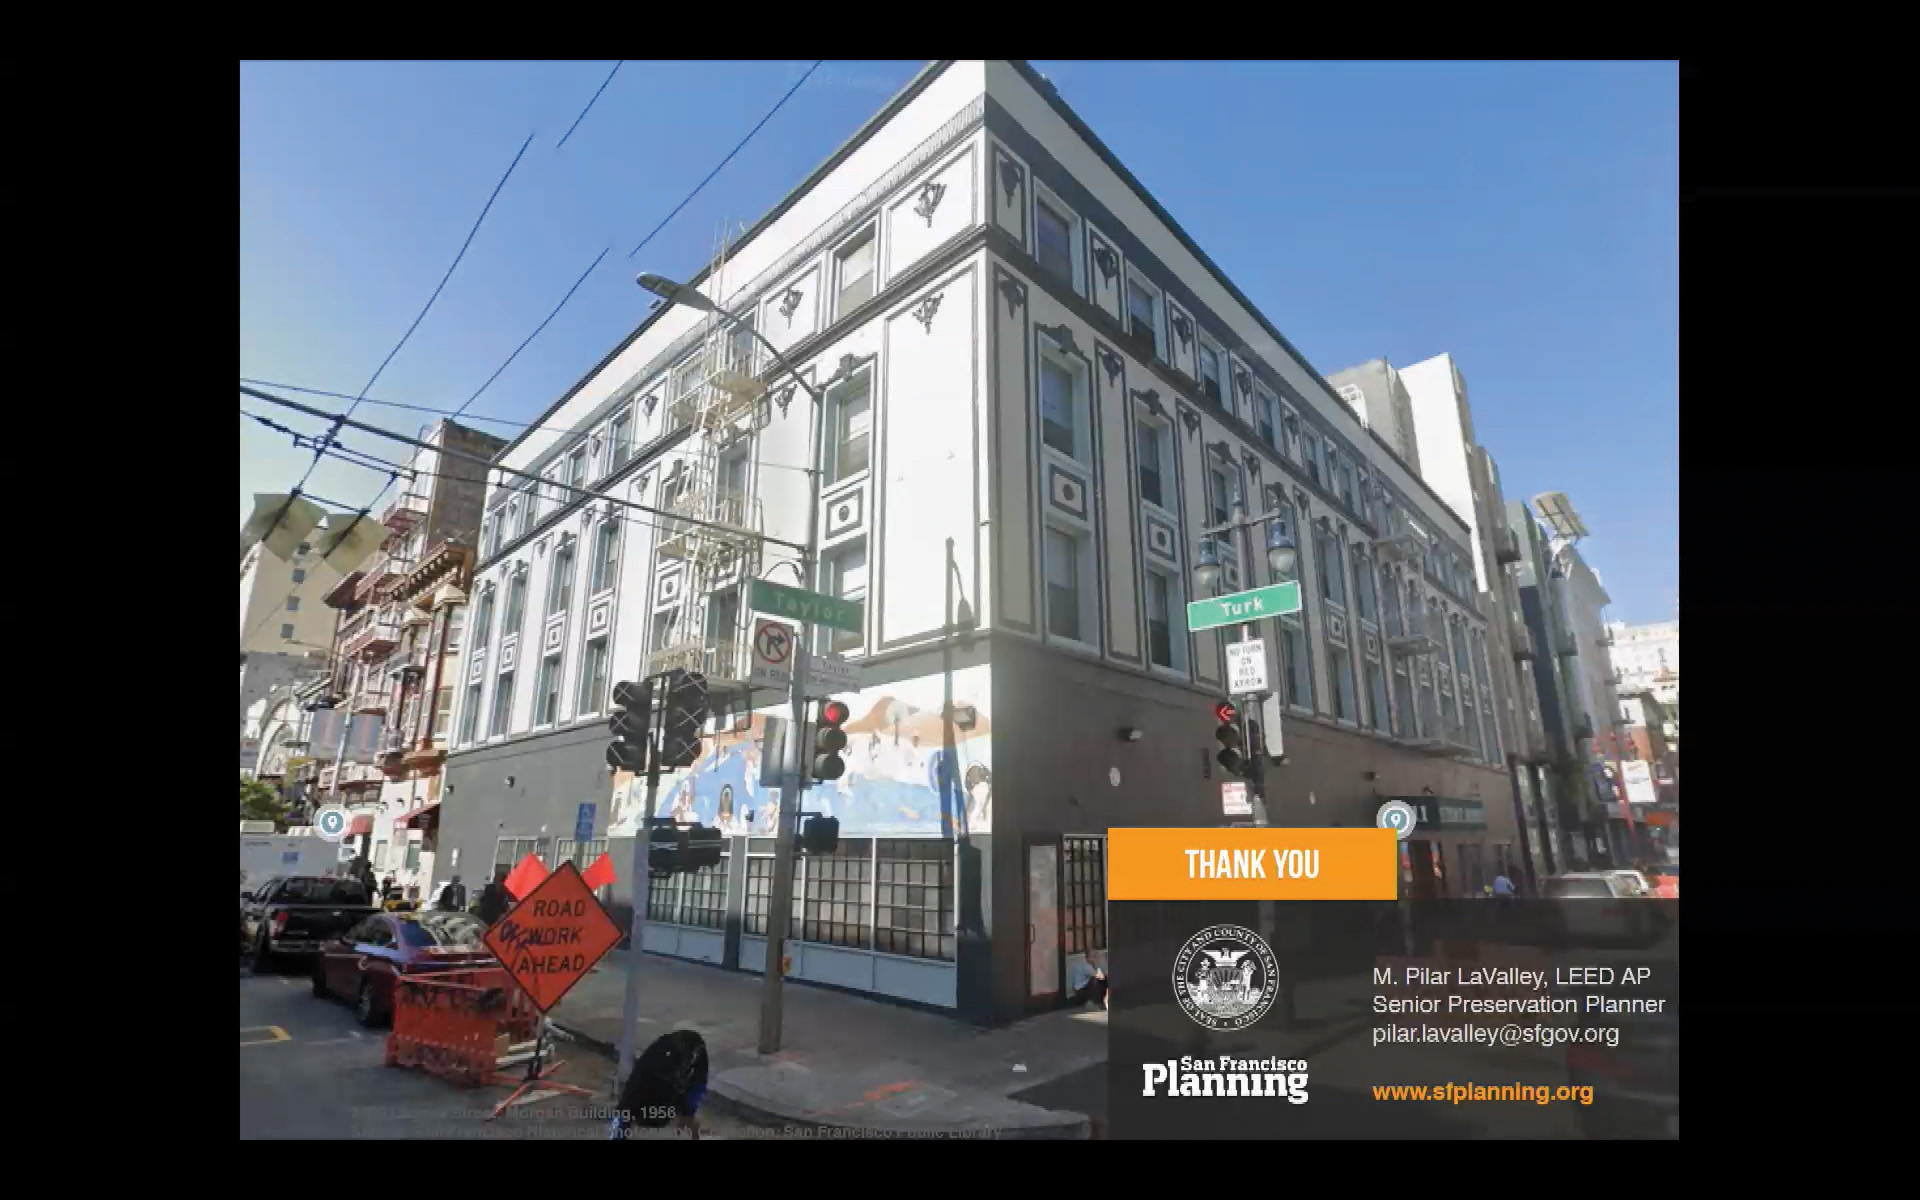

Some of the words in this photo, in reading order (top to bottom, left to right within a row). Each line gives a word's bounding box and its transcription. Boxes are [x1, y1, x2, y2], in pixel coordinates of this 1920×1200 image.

[775, 592, 845, 621] Taylor
[1220, 597, 1265, 616] Turk
[533, 900, 586, 917] ROAD
[528, 927, 582, 945] WORK
[517, 954, 585, 974] AHEAD
